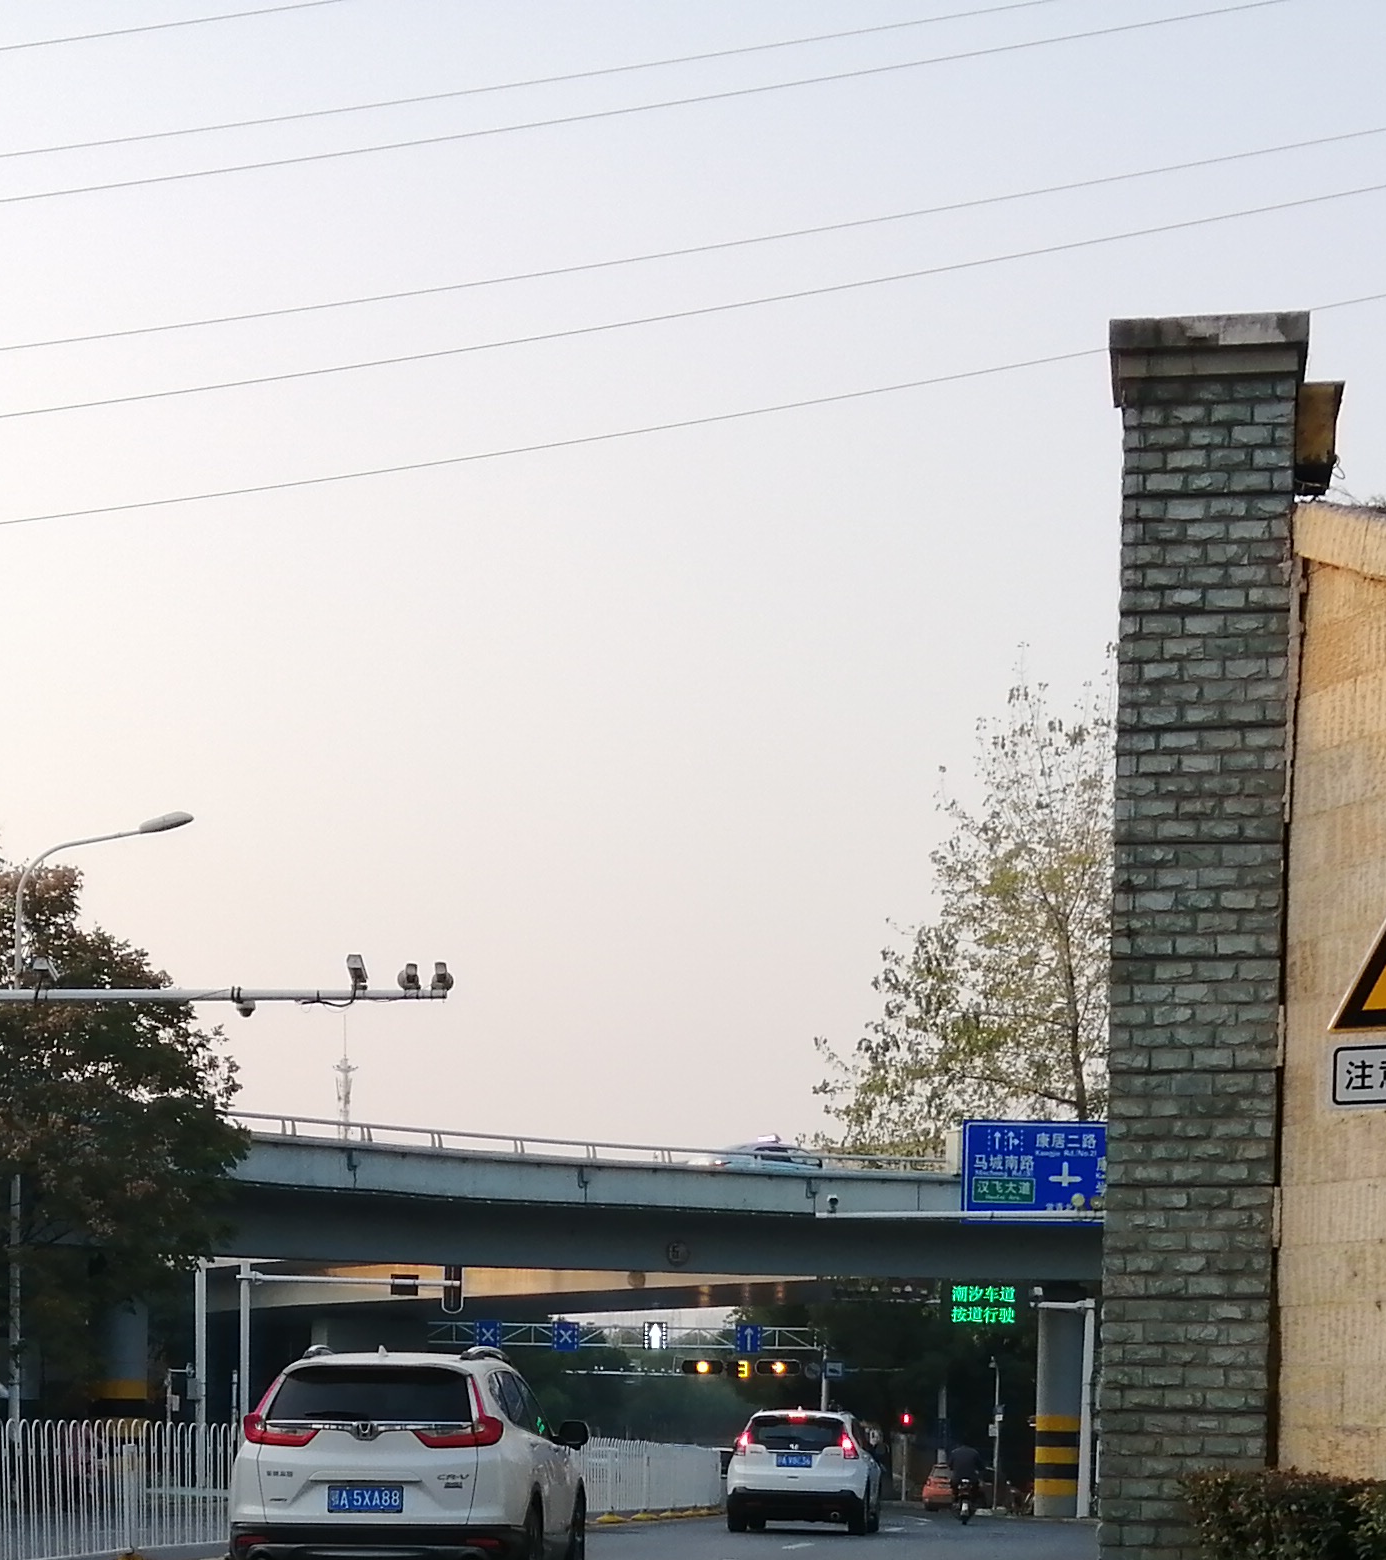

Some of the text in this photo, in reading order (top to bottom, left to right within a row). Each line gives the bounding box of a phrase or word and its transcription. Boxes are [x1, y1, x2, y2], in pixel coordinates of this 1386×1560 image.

[1035, 1132, 1097, 1149] 康居二路
[973, 1154, 1035, 1171] 马城南路
[977, 1180, 1031, 1195] 汉飞大道
[951, 1285, 1016, 1303] 潮汐车道
[950, 1306, 1016, 1324] 按道行驶
